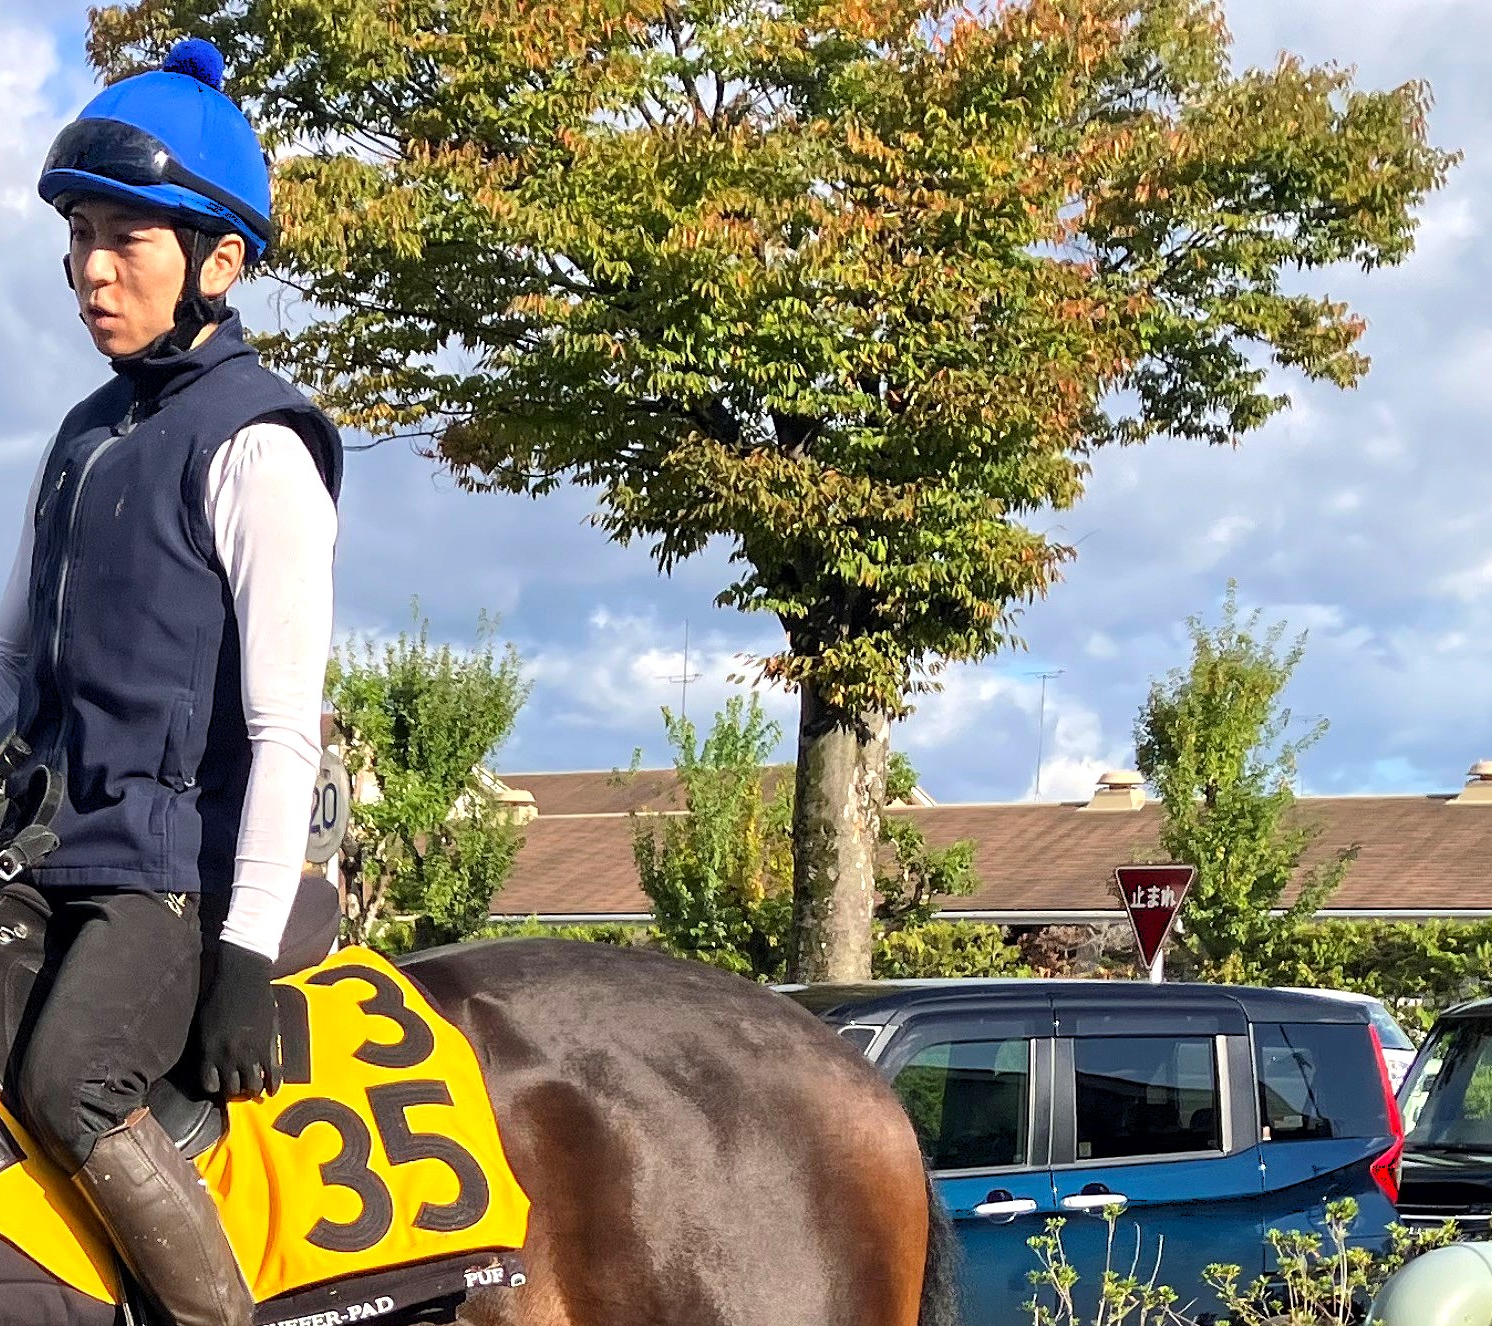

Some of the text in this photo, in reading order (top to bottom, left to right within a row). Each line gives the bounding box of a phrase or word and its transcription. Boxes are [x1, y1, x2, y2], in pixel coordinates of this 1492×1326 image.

[309, 782, 337, 834] 20
[1129, 884, 1177, 909] 止まれ
[271, 964, 435, 1084] 13
[271, 1079, 490, 1252] 35
